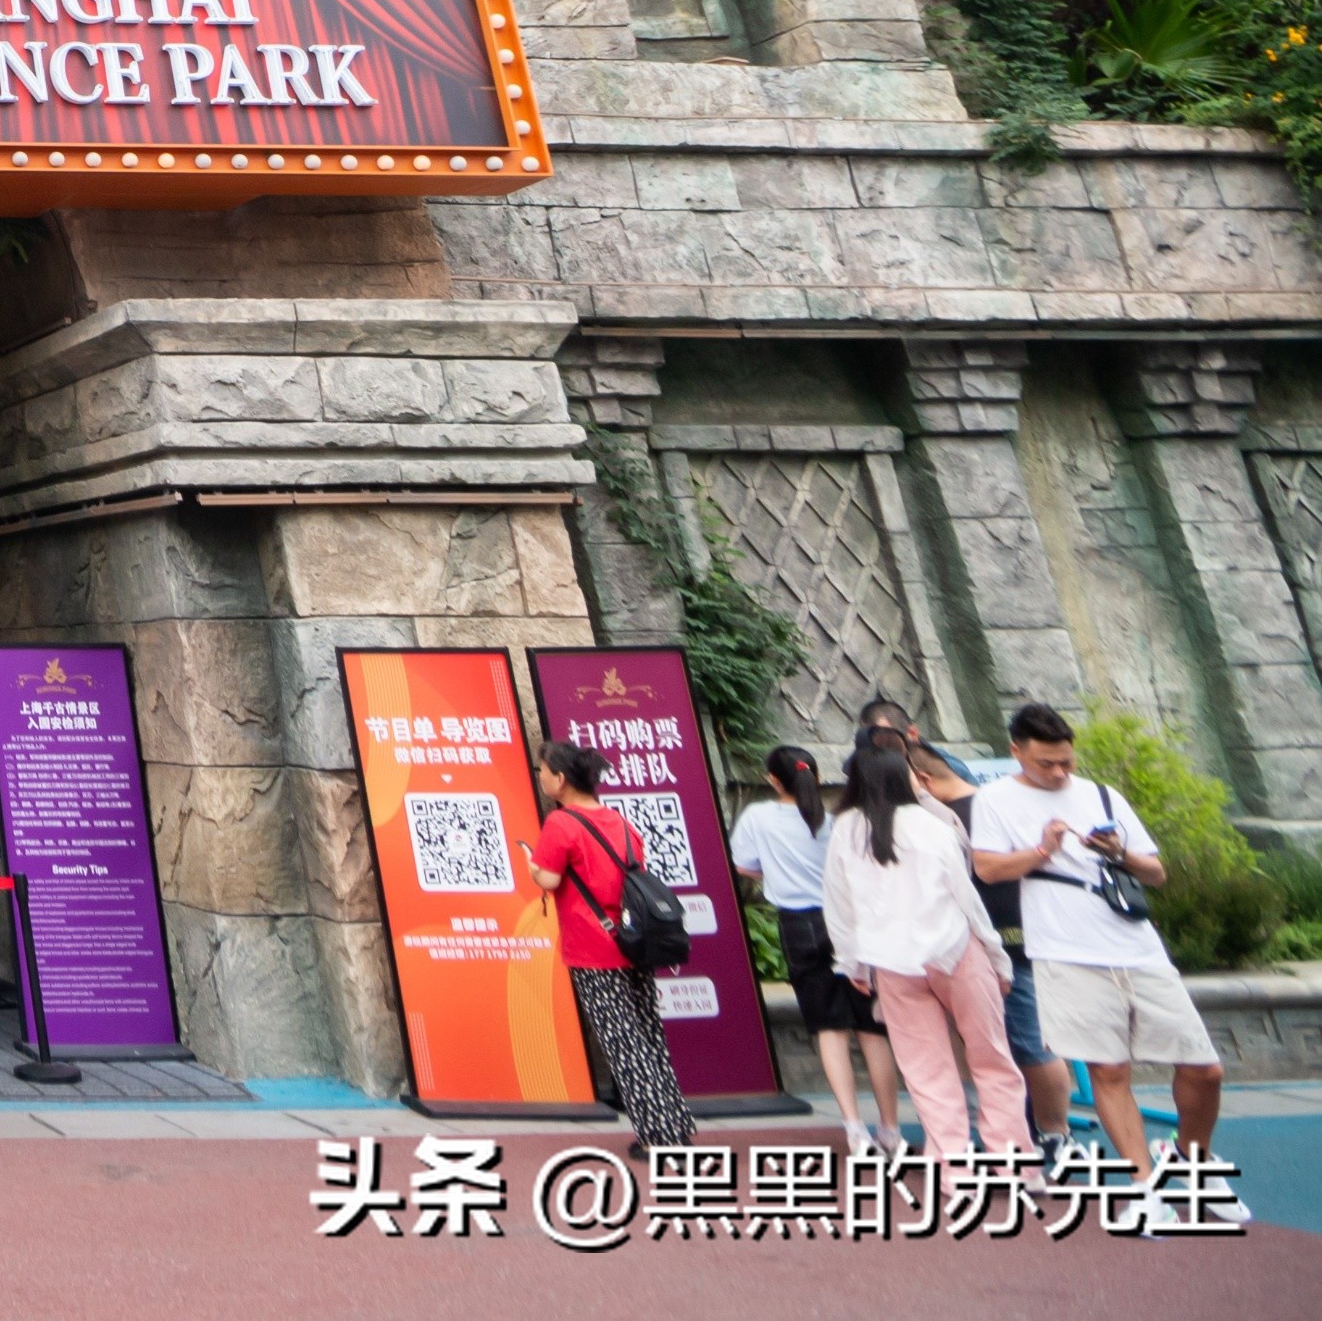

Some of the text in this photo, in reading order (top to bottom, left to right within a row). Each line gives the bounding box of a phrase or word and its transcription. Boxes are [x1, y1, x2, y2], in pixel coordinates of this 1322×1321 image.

[163, 42, 379, 108] PARK
[20, 701, 101, 715] 上海千古情景区
[27, 716, 98, 730] 入园安检须知
[365, 717, 512, 743] 节目单 导览图
[568, 716, 683, 751] 扫码购票
[394, 747, 492, 764] 微信扫码获取
[51, 864, 109, 876] Security Tips
